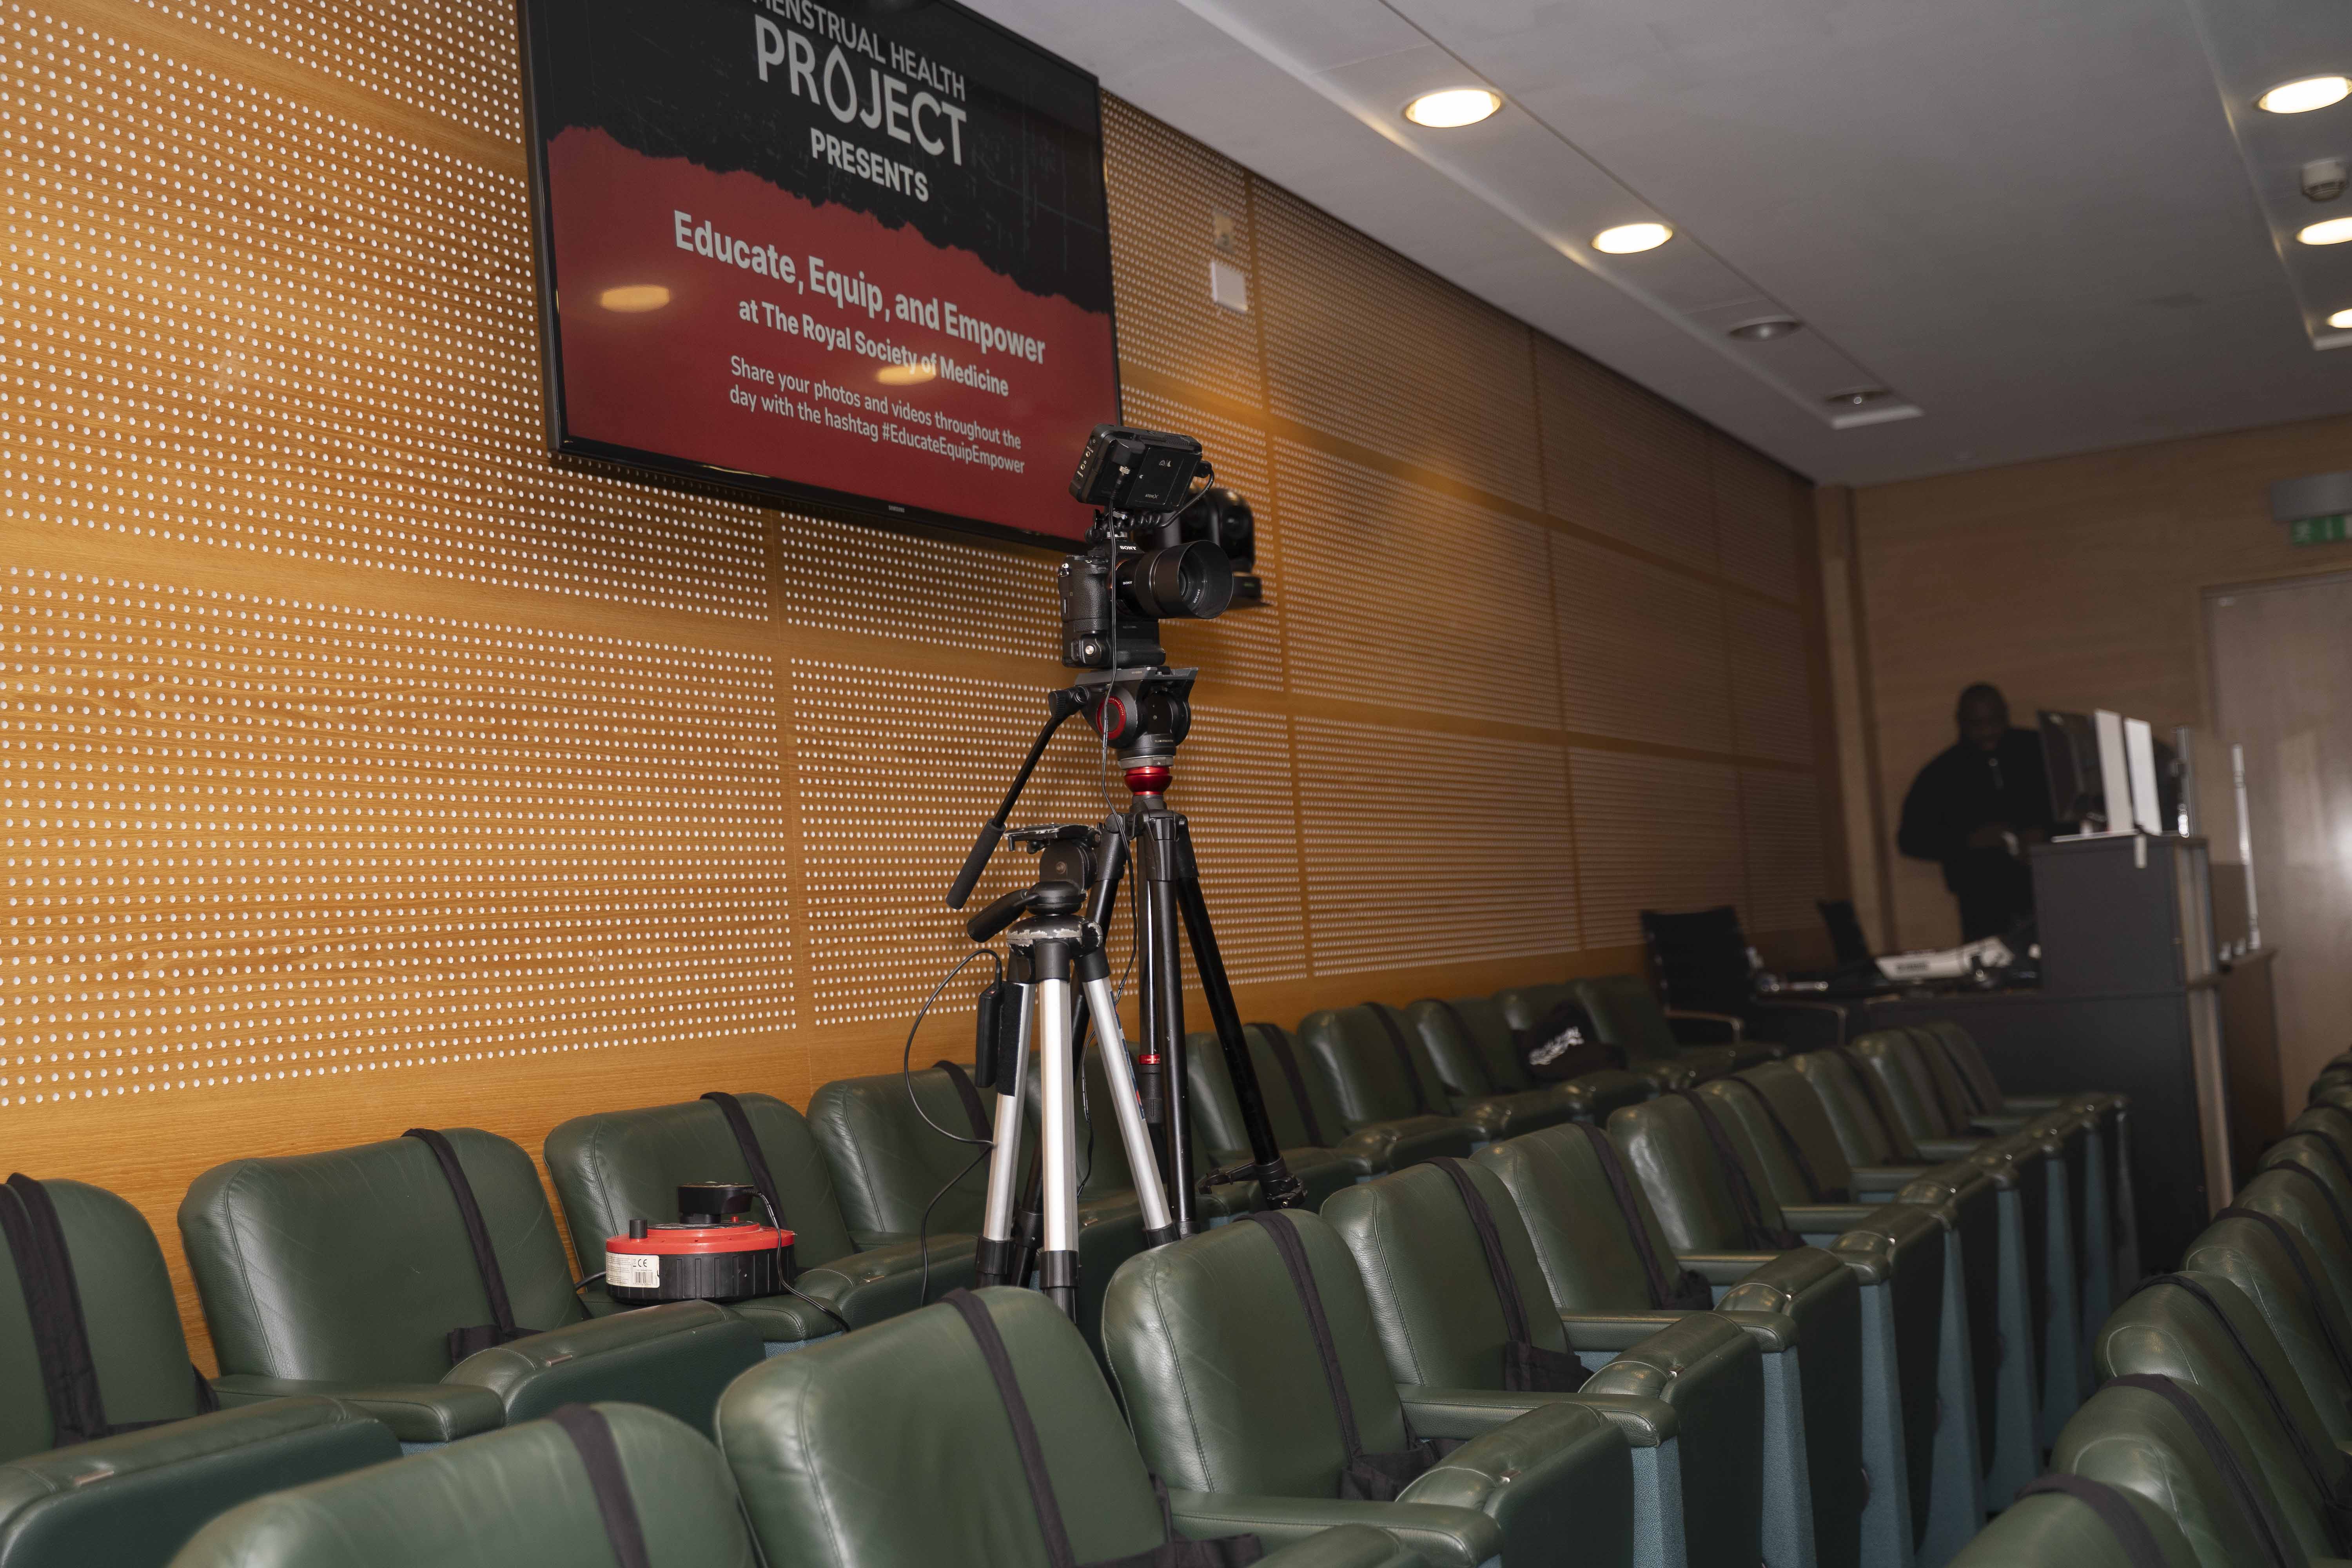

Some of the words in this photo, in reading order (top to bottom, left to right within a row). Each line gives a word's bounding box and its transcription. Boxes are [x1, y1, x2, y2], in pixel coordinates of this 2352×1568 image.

[752, 0, 886, 64] ENSTRUAL
[890, 42, 965, 102] HEALTH
[755, 14, 967, 166] PROJECT
[810, 127, 929, 202] PRESENTS
[674, 210, 804, 295] Educate,
[808, 255, 890, 323] Equip,
[895, 294, 940, 331] and
[944, 301, 1046, 364] Empower
[739, 299, 759, 324] at
[762, 301, 799, 335] The
[802, 314, 851, 350] Royal
[855, 330, 917, 374] Society
[921, 352, 937, 376] of
[940, 356, 1009, 397] Medicine
[730, 384, 757, 412] day
[760, 394, 794, 417] with
[797, 401, 821, 424] the
[825, 407, 878, 442] hashtag
[882, 421, 1025, 474] #EducateEquipEmpower
[731, 355, 775, 385] Share
[778, 373, 810, 394] your
[814, 379, 861, 408] photos
[864, 396, 888, 415] and
[891, 400, 932, 426] videos
[934, 410, 1001, 445] throughout
[1002, 429, 1022, 450] the
